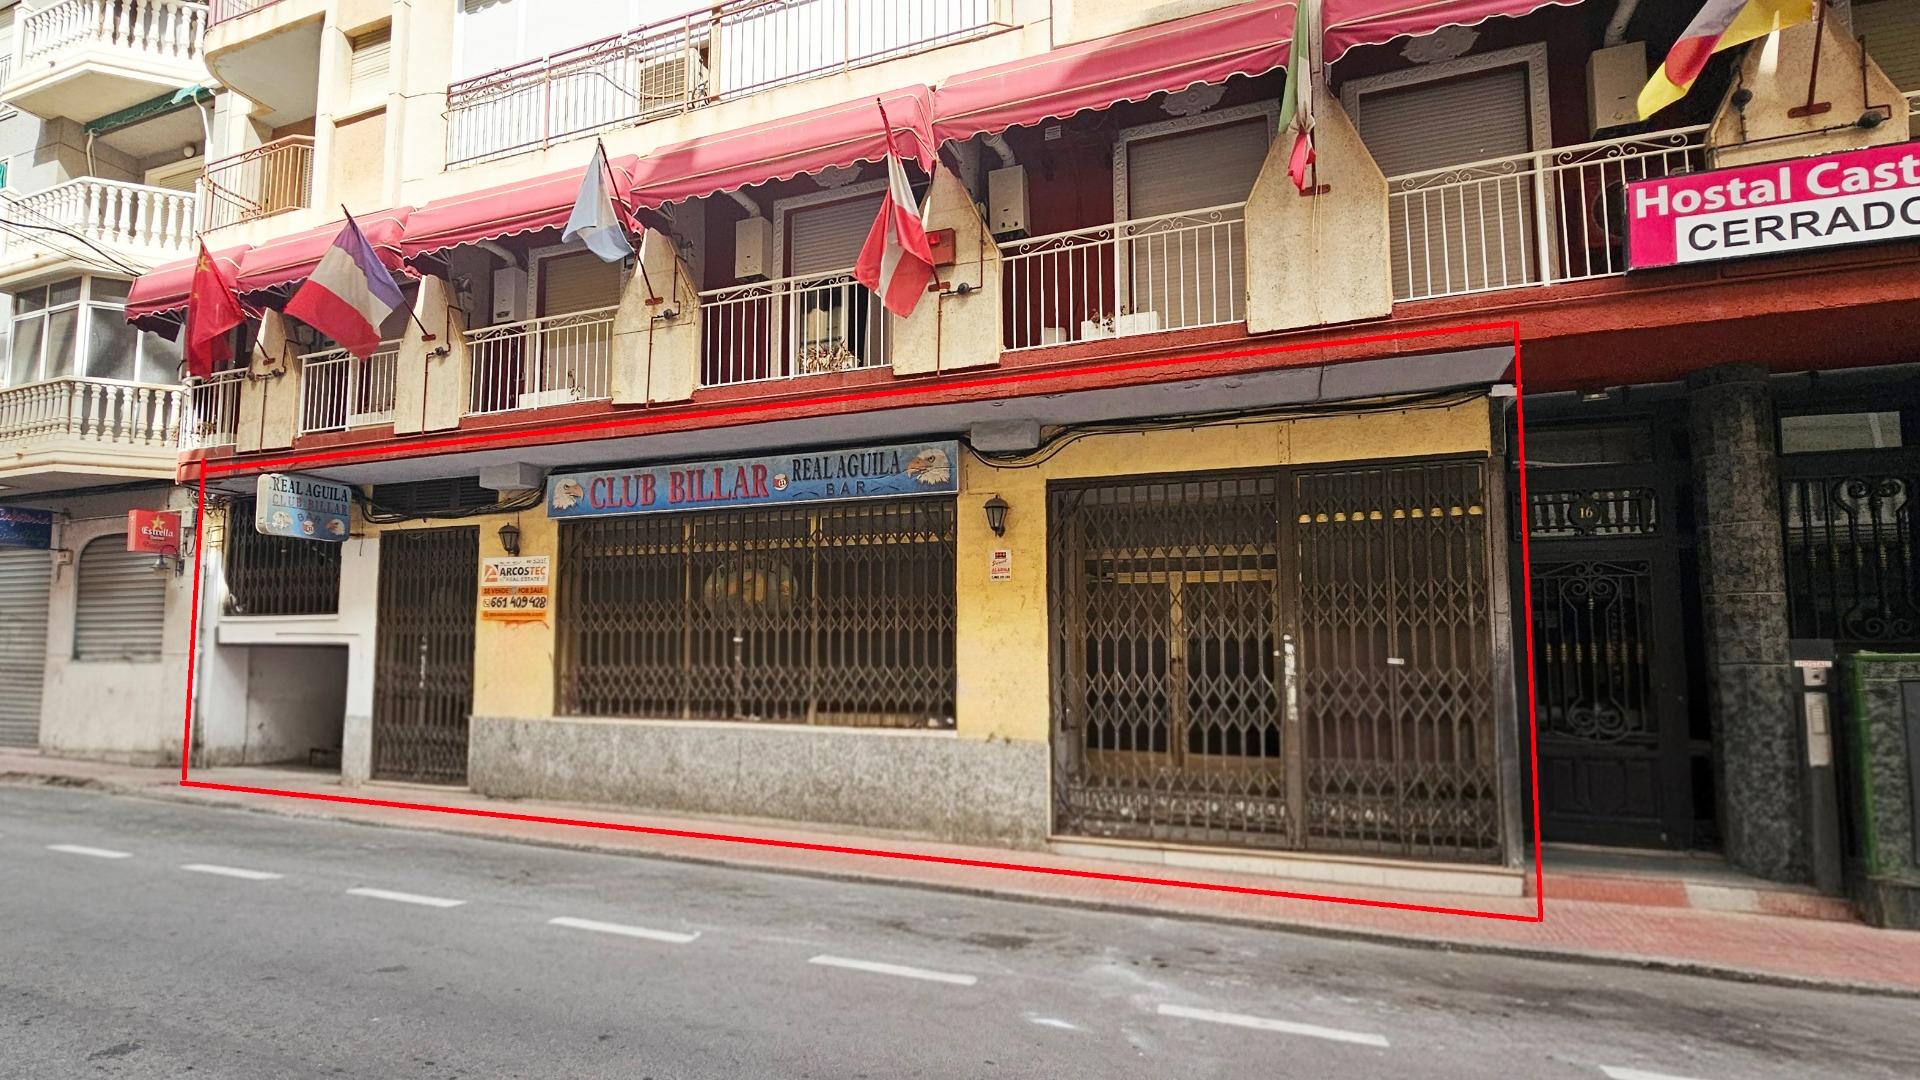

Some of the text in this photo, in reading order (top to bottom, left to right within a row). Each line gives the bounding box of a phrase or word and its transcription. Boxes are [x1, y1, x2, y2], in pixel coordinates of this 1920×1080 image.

[1635, 166, 1792, 219] Hostal
[1687, 195, 1920, 251] CERRADO
[791, 450, 901, 482] REAL AGUILA
[271, 476, 348, 502] REAL AGUILA
[589, 463, 770, 509] CLUB BILLAR
[825, 480, 866, 497] BAR
[272, 493, 348, 515] CLUB BILLAR
[1580, 506, 1593, 519] 16
[297, 512, 322, 525] BAR
[141, 526, 174, 538] Estrella
[500, 566, 546, 576] ARCOSTEC
[491, 596, 507, 608] 661
[509, 596, 529, 609] 409
